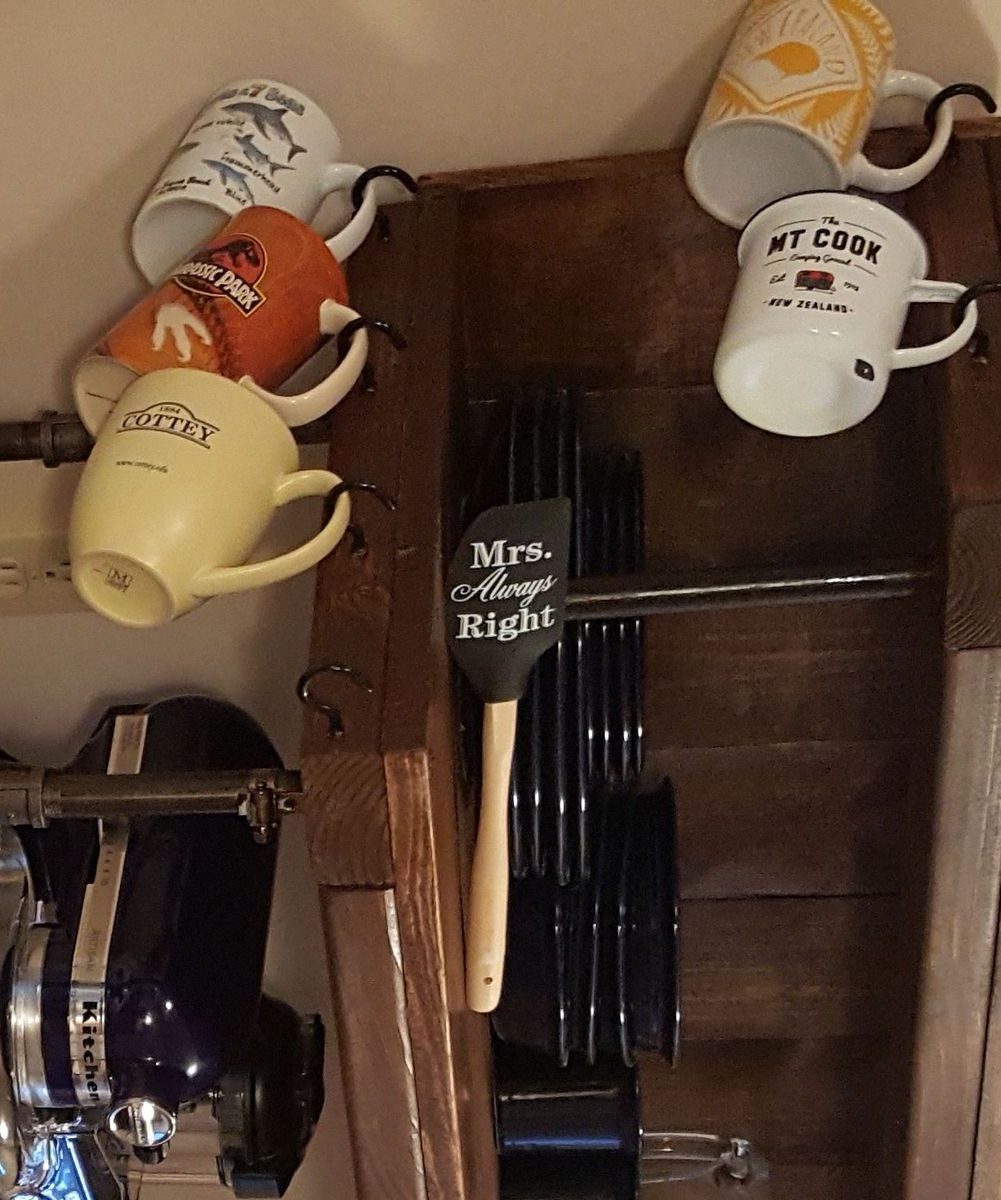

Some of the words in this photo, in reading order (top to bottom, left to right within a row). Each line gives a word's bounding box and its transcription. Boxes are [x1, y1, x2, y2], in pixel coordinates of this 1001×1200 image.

[766, 229, 807, 257] MT
[812, 228, 882, 265] COOK
[213, 270, 259, 310] PARK
[767, 298, 793, 308] NEW
[796, 300, 848, 314] ZEALAND
[122, 413, 216, 442] COTTEY
[469, 540, 553, 569] Mrs.
[450, 566, 559, 608] Always
[455, 604, 557, 642] Right
